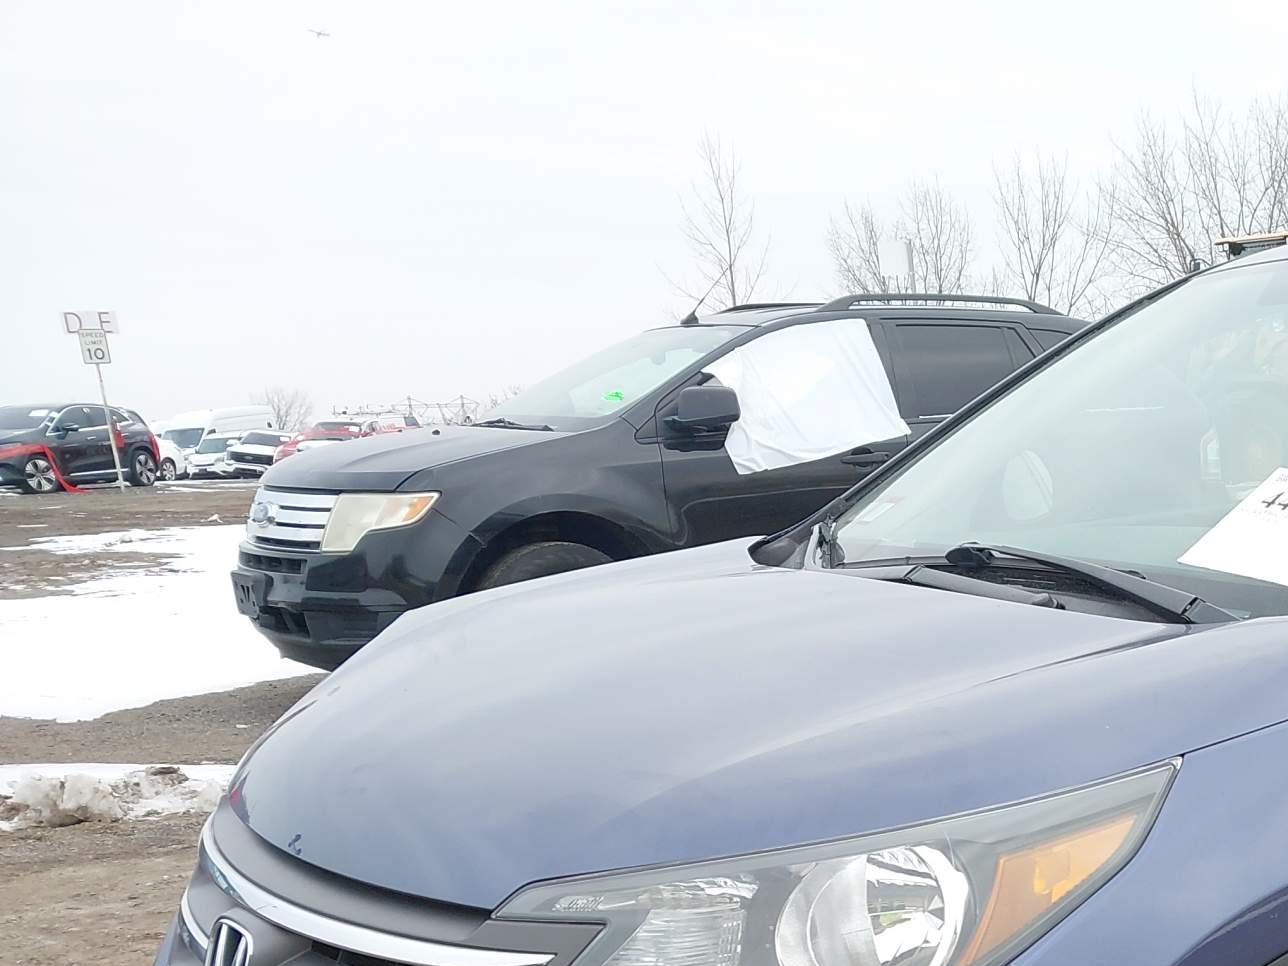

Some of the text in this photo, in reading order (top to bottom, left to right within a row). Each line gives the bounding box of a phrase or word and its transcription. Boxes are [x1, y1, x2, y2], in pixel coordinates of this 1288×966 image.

[64, 311, 114, 333] D E
[87, 347, 105, 360] 10
